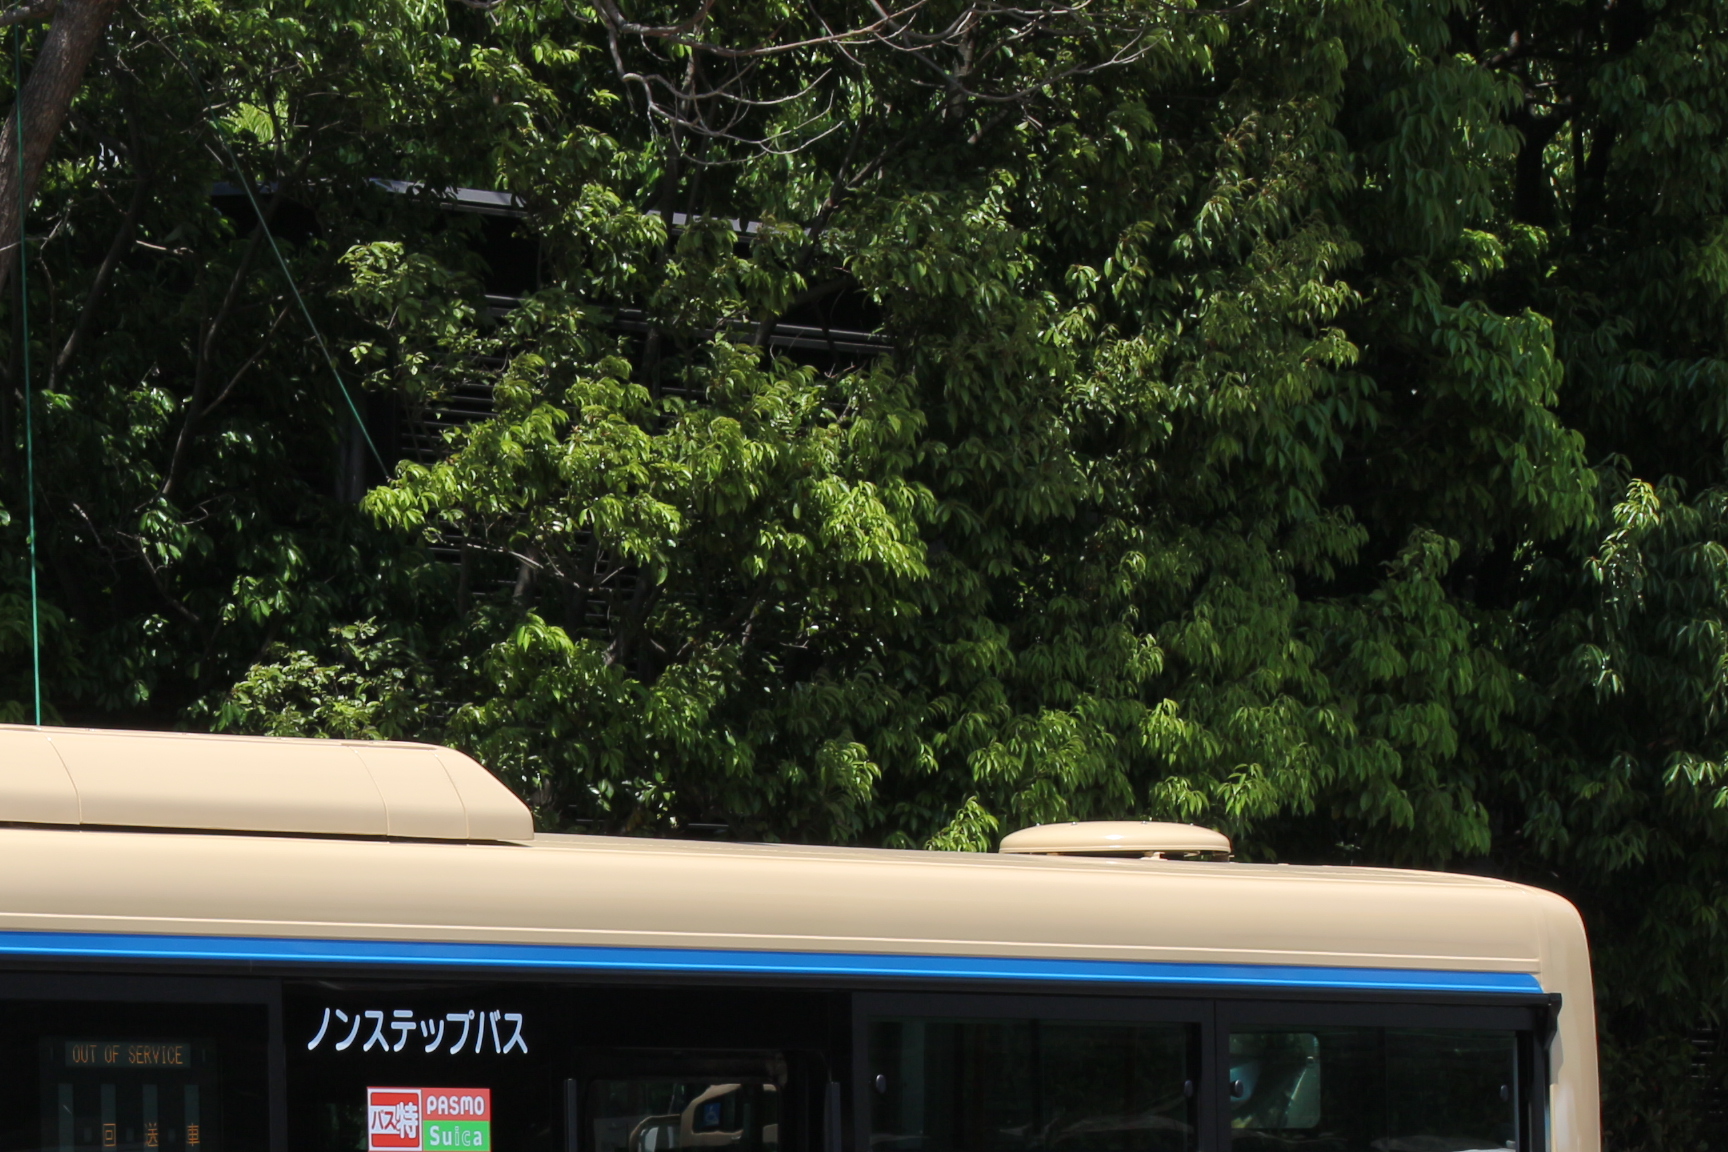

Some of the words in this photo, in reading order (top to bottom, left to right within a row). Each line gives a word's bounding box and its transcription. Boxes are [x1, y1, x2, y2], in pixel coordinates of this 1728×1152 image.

[307, 1007, 528, 1055] ノンステップバス
[72, 1044, 97, 1064] OUT
[104, 1044, 120, 1064] OF
[128, 1044, 183, 1065] SERVICE
[426, 1095, 485, 1115] PASMO
[103, 1122, 200, 1147] 回送車
[429, 1125, 483, 1146] Suica
